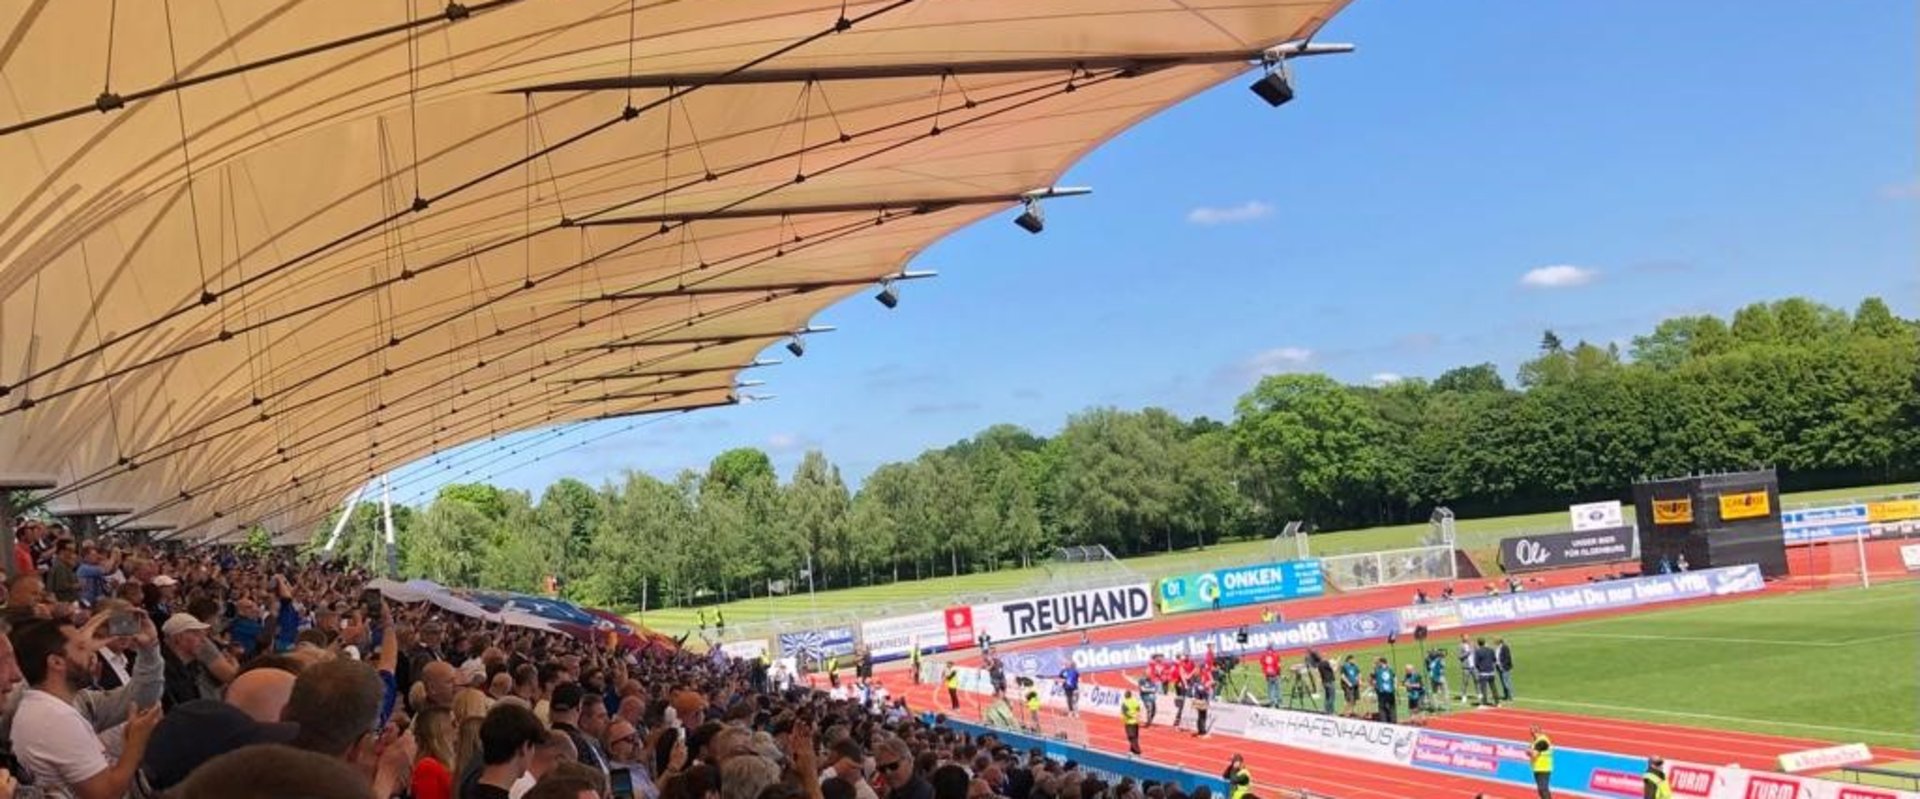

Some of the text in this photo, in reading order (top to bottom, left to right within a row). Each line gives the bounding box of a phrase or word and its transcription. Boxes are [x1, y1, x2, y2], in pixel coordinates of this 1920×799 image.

[1224, 568, 1283, 588] ONKEN
[1002, 586, 1149, 636] TREUHAND
[1460, 598, 1516, 621] Richtig
[1516, 594, 1550, 612] blau
[1583, 588, 1607, 605] Du
[1287, 713, 1394, 746] HAFENHAUS
[1673, 769, 1711, 793] TURM
[1749, 779, 1793, 799] TURM
